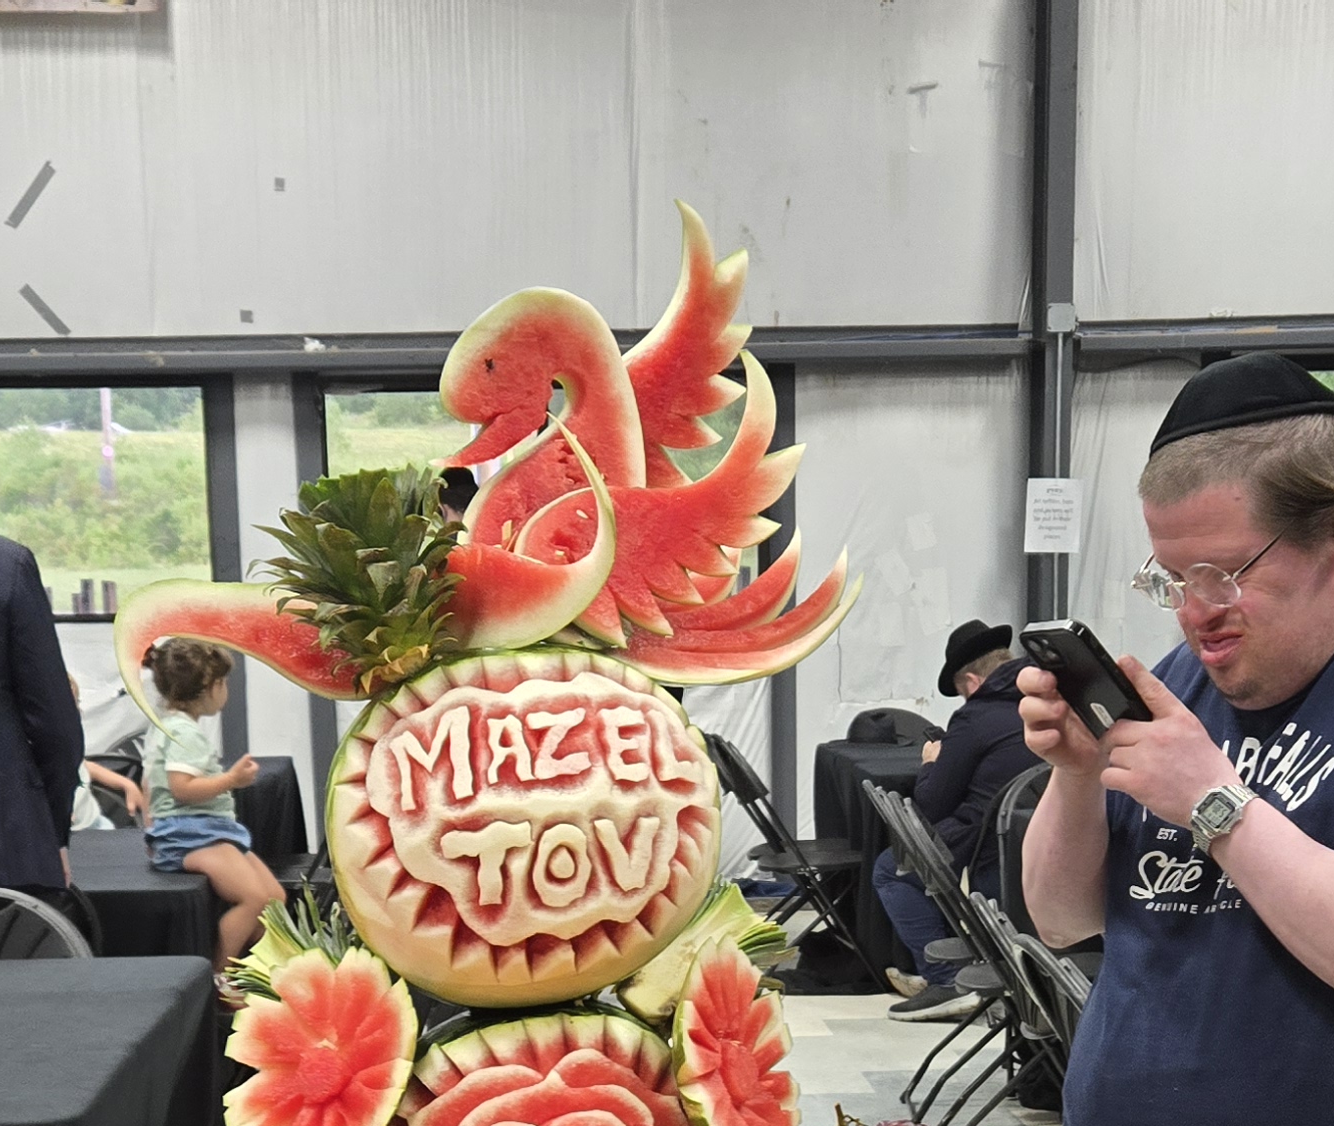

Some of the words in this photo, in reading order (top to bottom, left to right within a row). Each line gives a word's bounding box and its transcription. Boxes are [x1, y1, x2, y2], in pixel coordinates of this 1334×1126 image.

[391, 705, 700, 811] MAZEL
[441, 817, 660, 908] TOV
[1156, 828, 1178, 842] EST.
